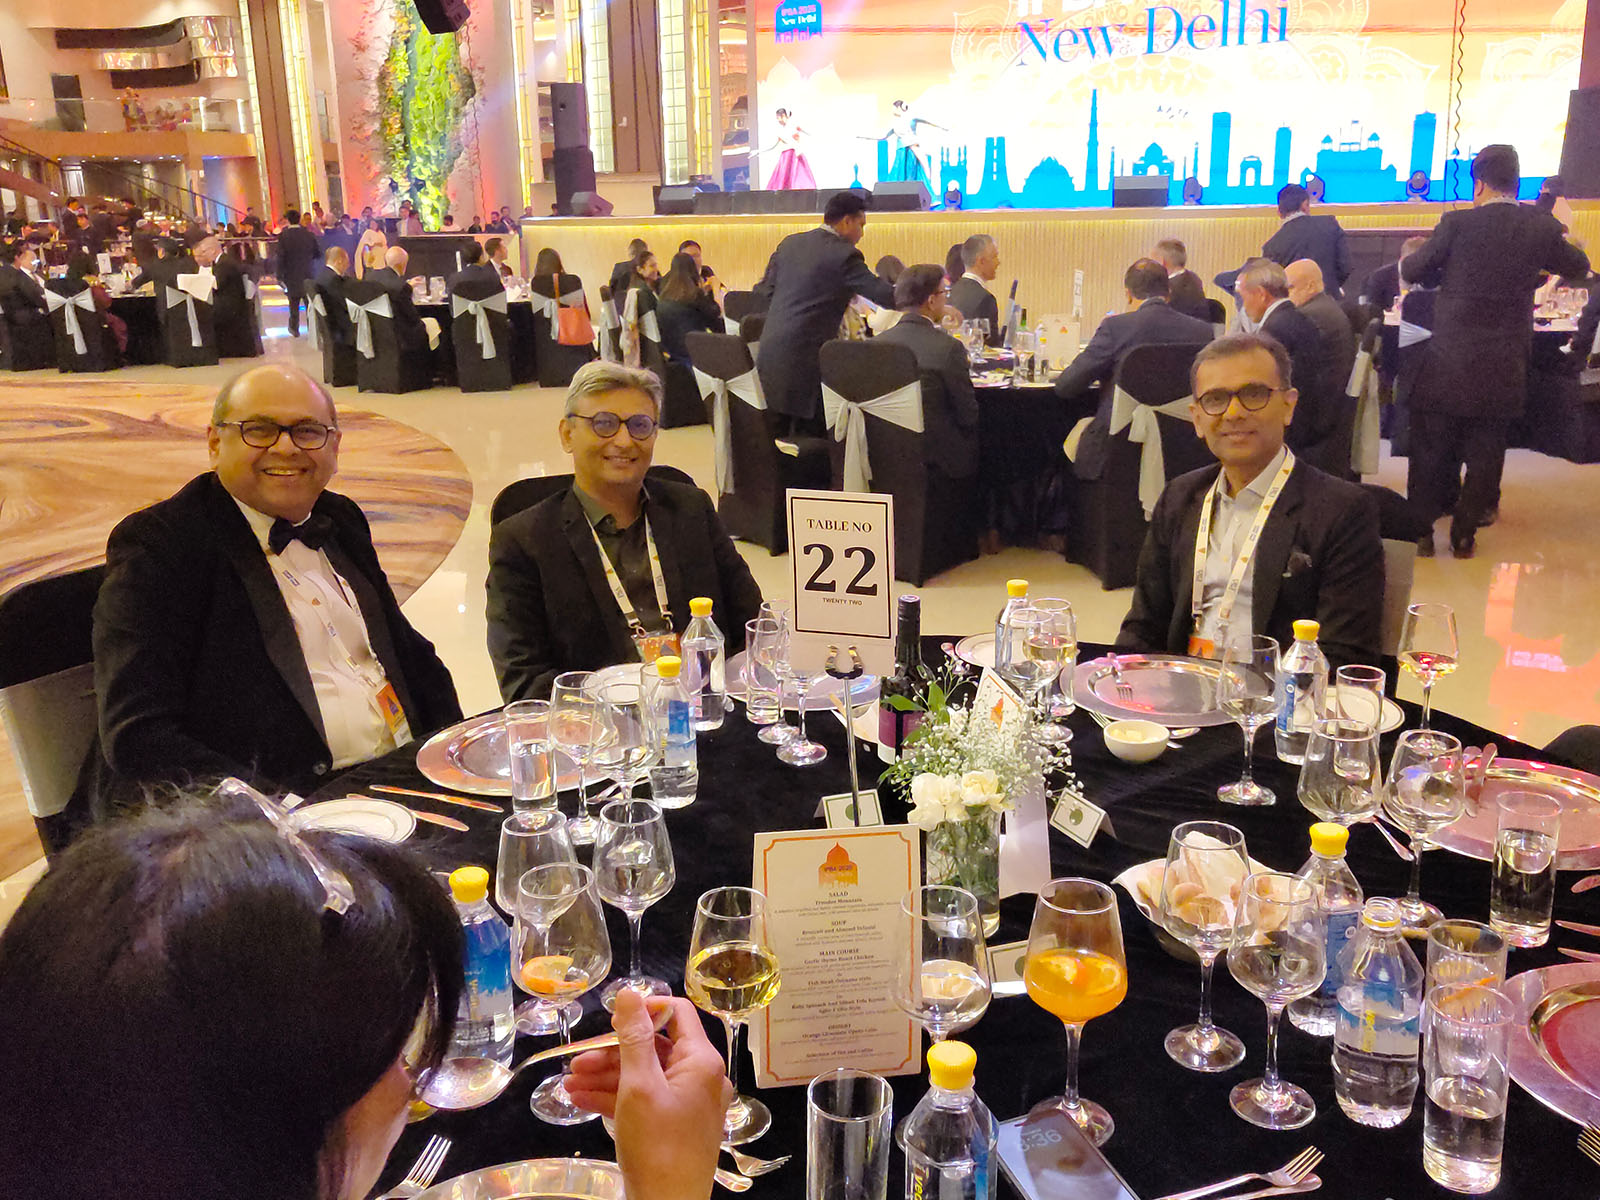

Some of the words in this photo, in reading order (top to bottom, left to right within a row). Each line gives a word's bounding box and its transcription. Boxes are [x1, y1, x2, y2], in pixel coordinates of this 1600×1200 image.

[1016, 18, 1126, 66] New
[1142, 0, 1289, 55] Delhi
[807, 519, 849, 531] TABLE
[852, 522, 872, 533] NO
[804, 544, 878, 596] 22
